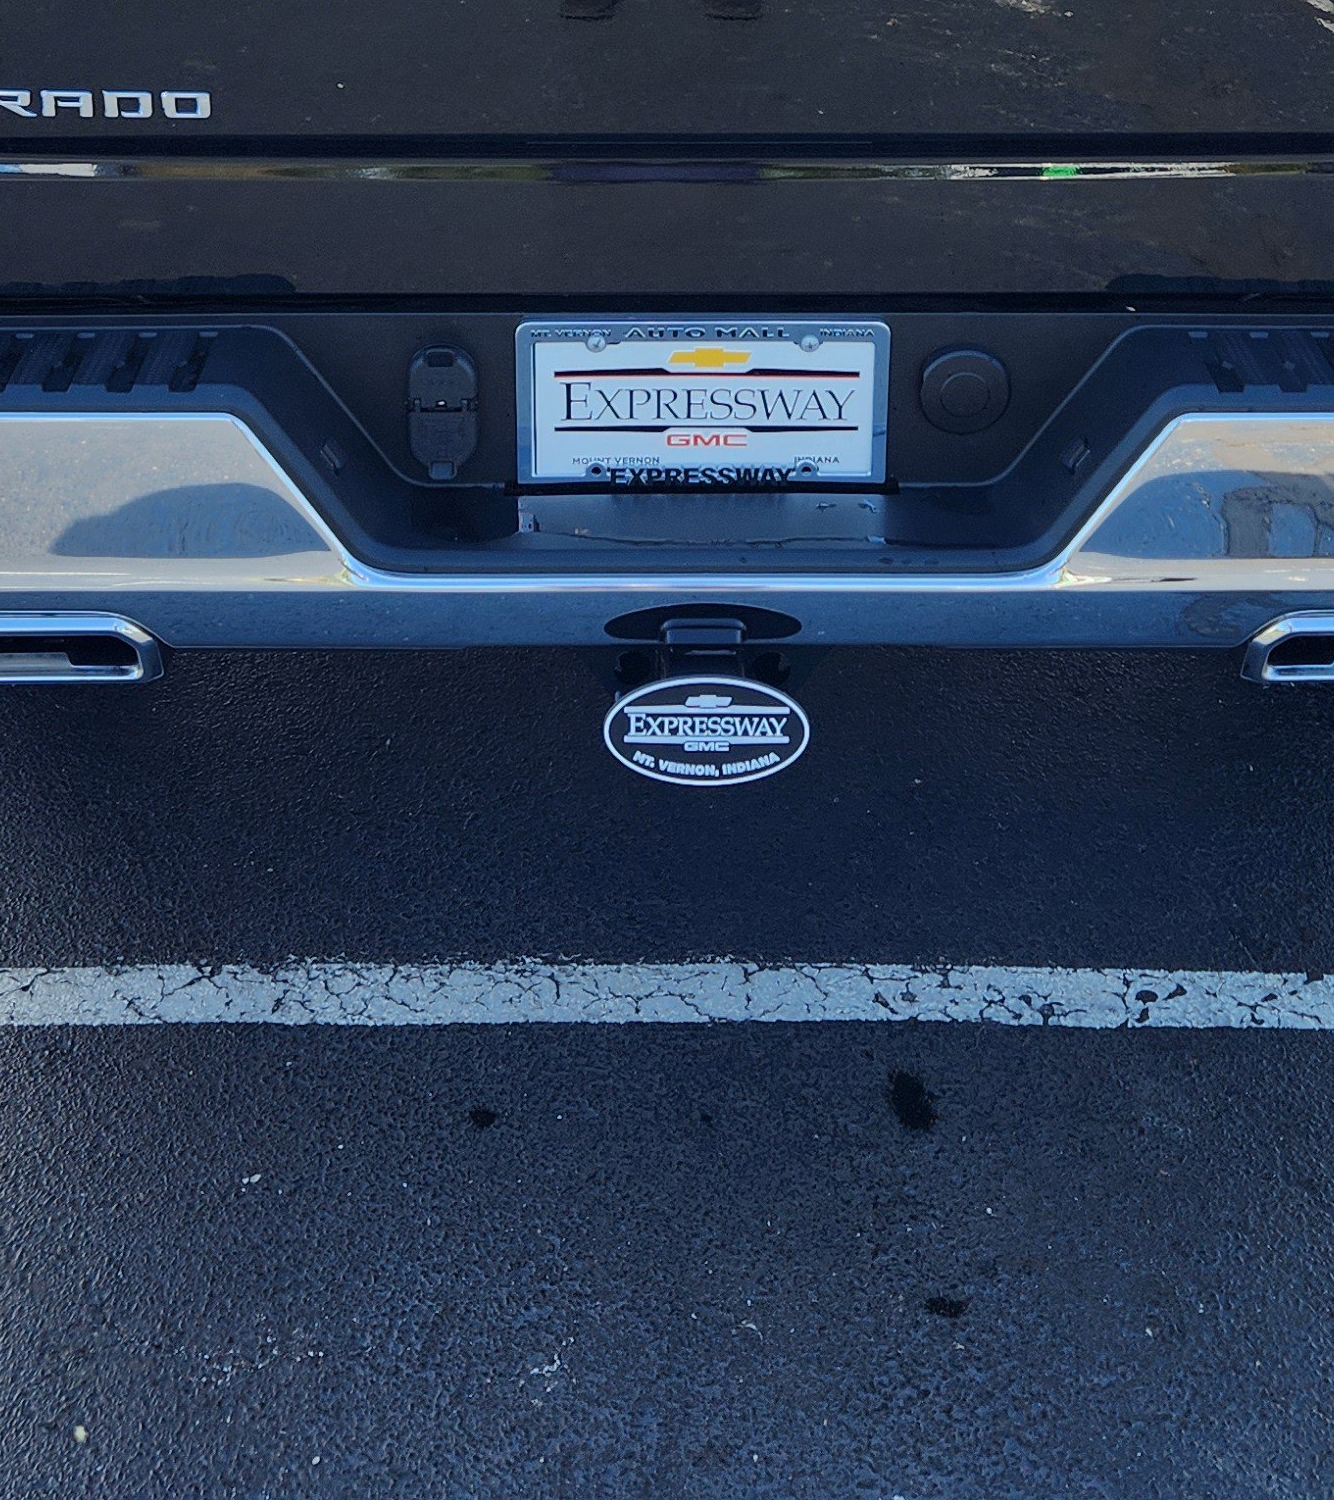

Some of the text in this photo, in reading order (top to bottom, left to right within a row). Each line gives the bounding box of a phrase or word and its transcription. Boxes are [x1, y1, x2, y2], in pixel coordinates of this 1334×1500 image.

[530, 329, 612, 338] MT. VERNON
[624, 326, 790, 339] AUTO MALL
[819, 328, 875, 337] INDIANA
[666, 433, 748, 447] GMC
[614, 456, 660, 465] VERNON
[609, 466, 792, 486] EXPRESSWAY
[627, 713, 787, 737] EXPRESSWAY
[684, 741, 729, 752] GMC
[632, 751, 780, 777] MT. VERNON, INDIANA
